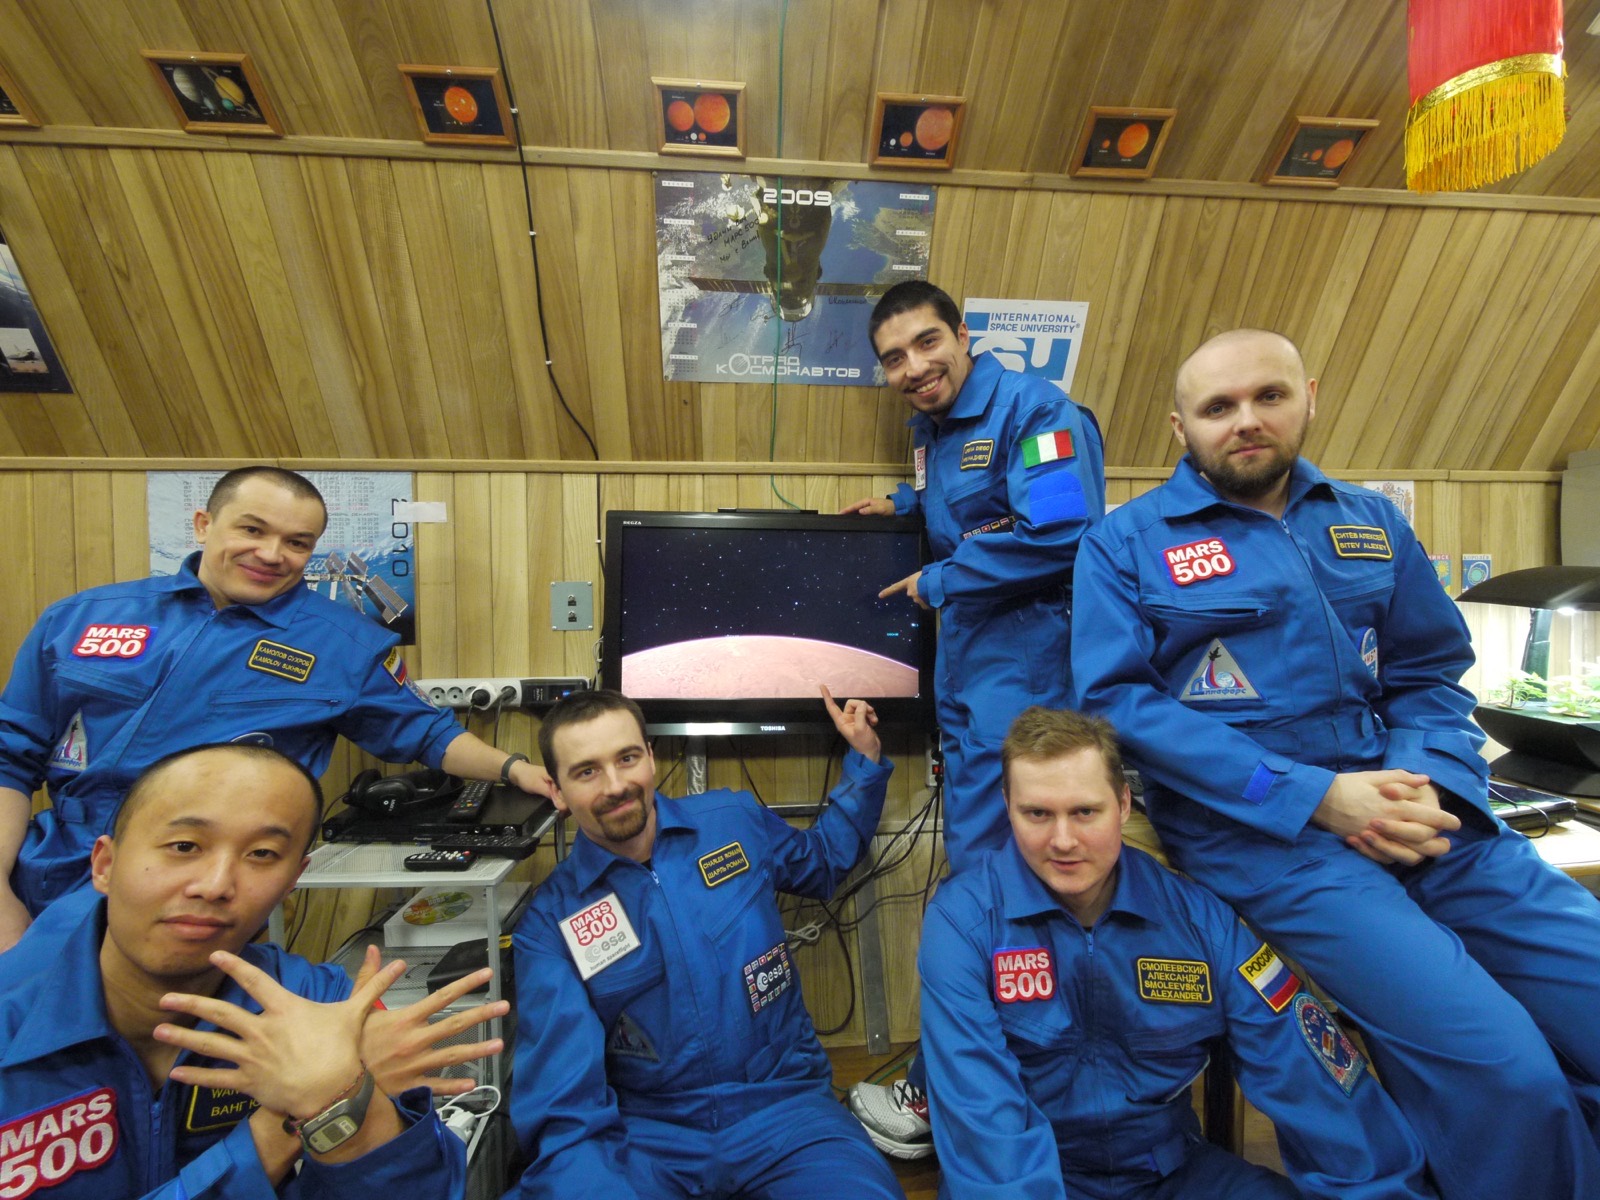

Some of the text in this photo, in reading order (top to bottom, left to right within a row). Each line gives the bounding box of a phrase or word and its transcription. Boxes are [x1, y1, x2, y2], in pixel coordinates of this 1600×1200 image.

[763, 188, 832, 206] 2009
[991, 312, 1076, 323] INTERNATIONAL
[990, 323, 1075, 333] SPACE UNIVERSITY
[1167, 540, 1224, 564] MARS
[1173, 553, 1232, 582] 500
[86, 626, 147, 639] MARS
[77, 638, 142, 656] 500
[571, 902, 611, 932] MARS
[577, 913, 617, 945] 500
[601, 930, 627, 952] esa
[997, 951, 1050, 973] MARS
[1140, 962, 1207, 975] СМОЛЕЕВСКИЙ
[767, 964, 784, 983] esa
[1147, 971, 1201, 983] АЛЕКСАНДР
[1000, 970, 1053, 1000] 500
[1144, 980, 1205, 993] SMOLEEVSKIY
[1150, 989, 1203, 1001] ALEXANDER
[211, 1088, 240, 1098] WAN
[211, 1100, 248, 1117] ВАНГ
[0, 1093, 112, 1158] MARS
[0, 1122, 114, 1199] 500
